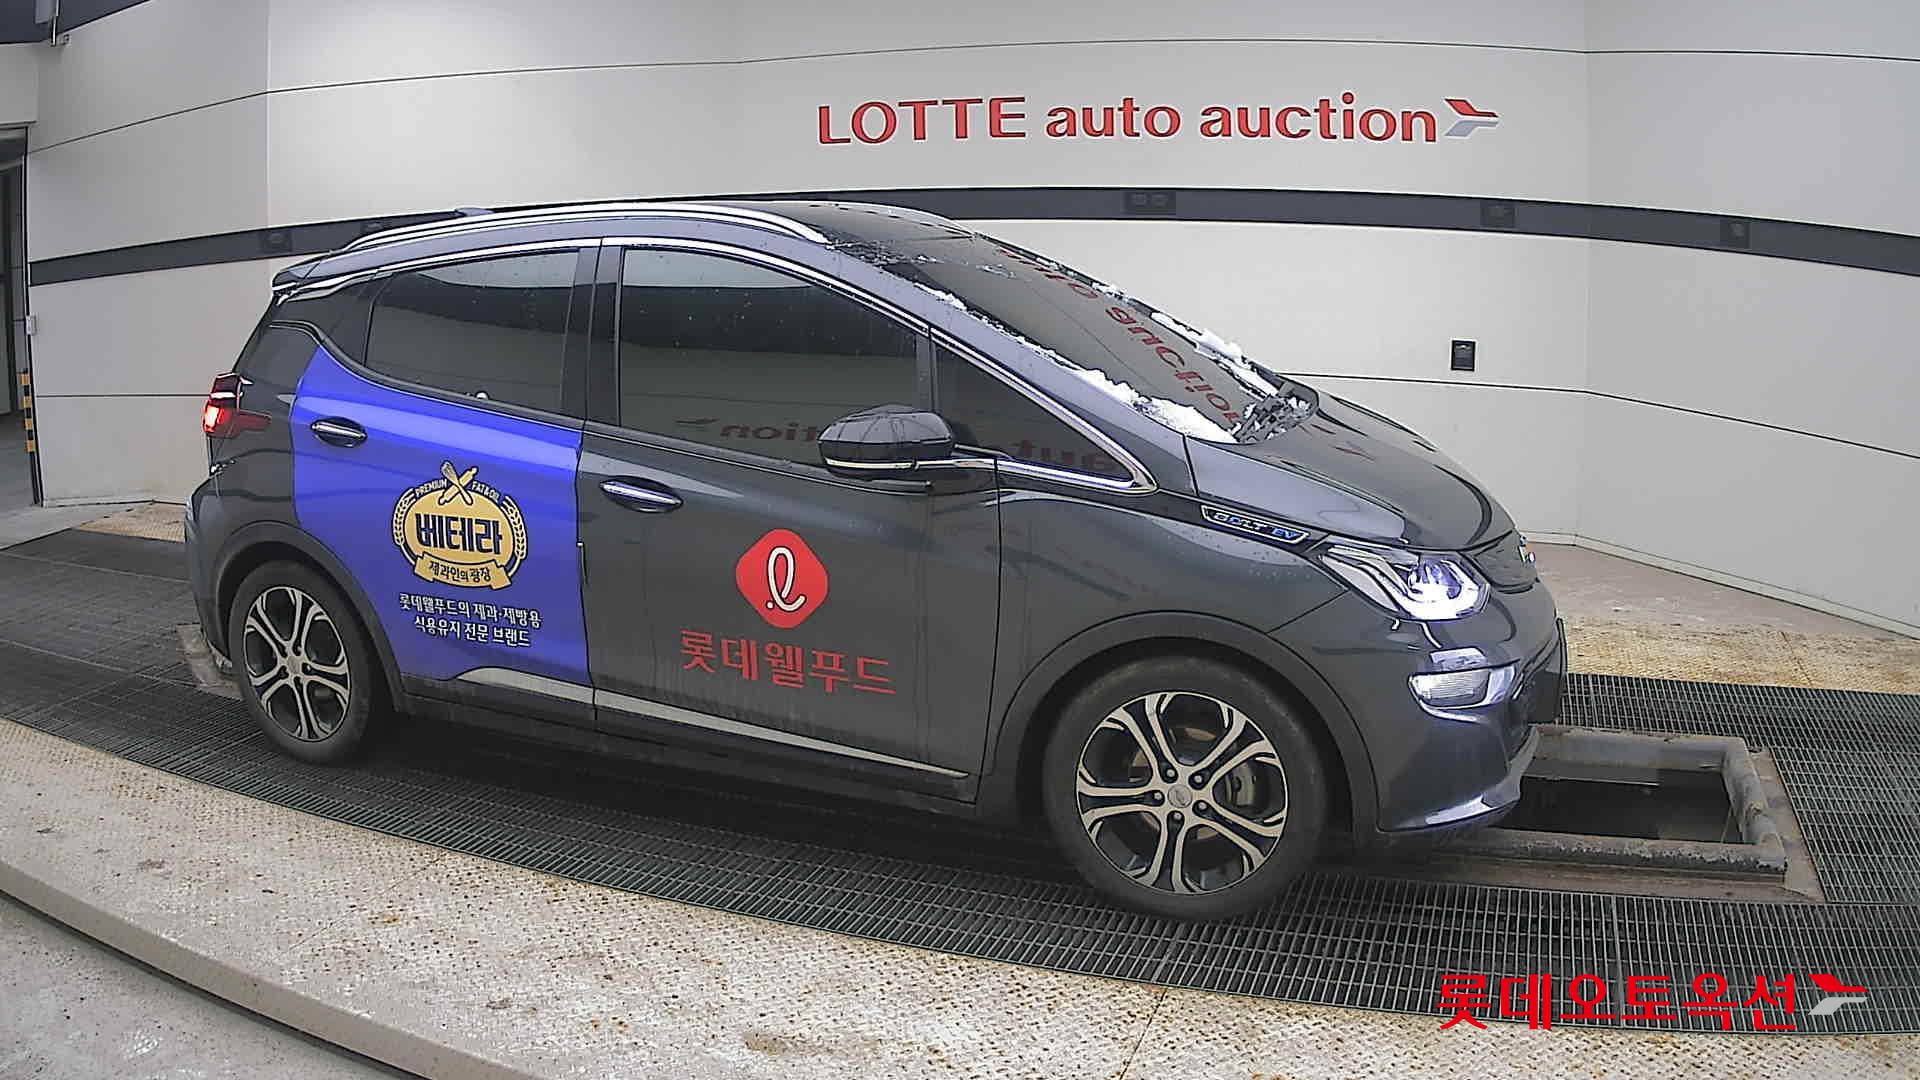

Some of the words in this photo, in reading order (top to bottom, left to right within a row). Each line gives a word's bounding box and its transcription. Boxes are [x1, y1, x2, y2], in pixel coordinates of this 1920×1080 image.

[817, 96, 1026, 145] LOTTE
[1046, 97, 1182, 138] auto
[1200, 92, 1437, 142] auction
[415, 512, 502, 555] 베테라
[428, 560, 469, 582] 제과인의
[399, 593, 470, 618] 롯데웰푸드의
[414, 615, 461, 640] 식용유지
[464, 622, 489, 643] 전문
[492, 626, 531, 647] 브랜드
[680, 629, 896, 695] 롯데웰푸드
